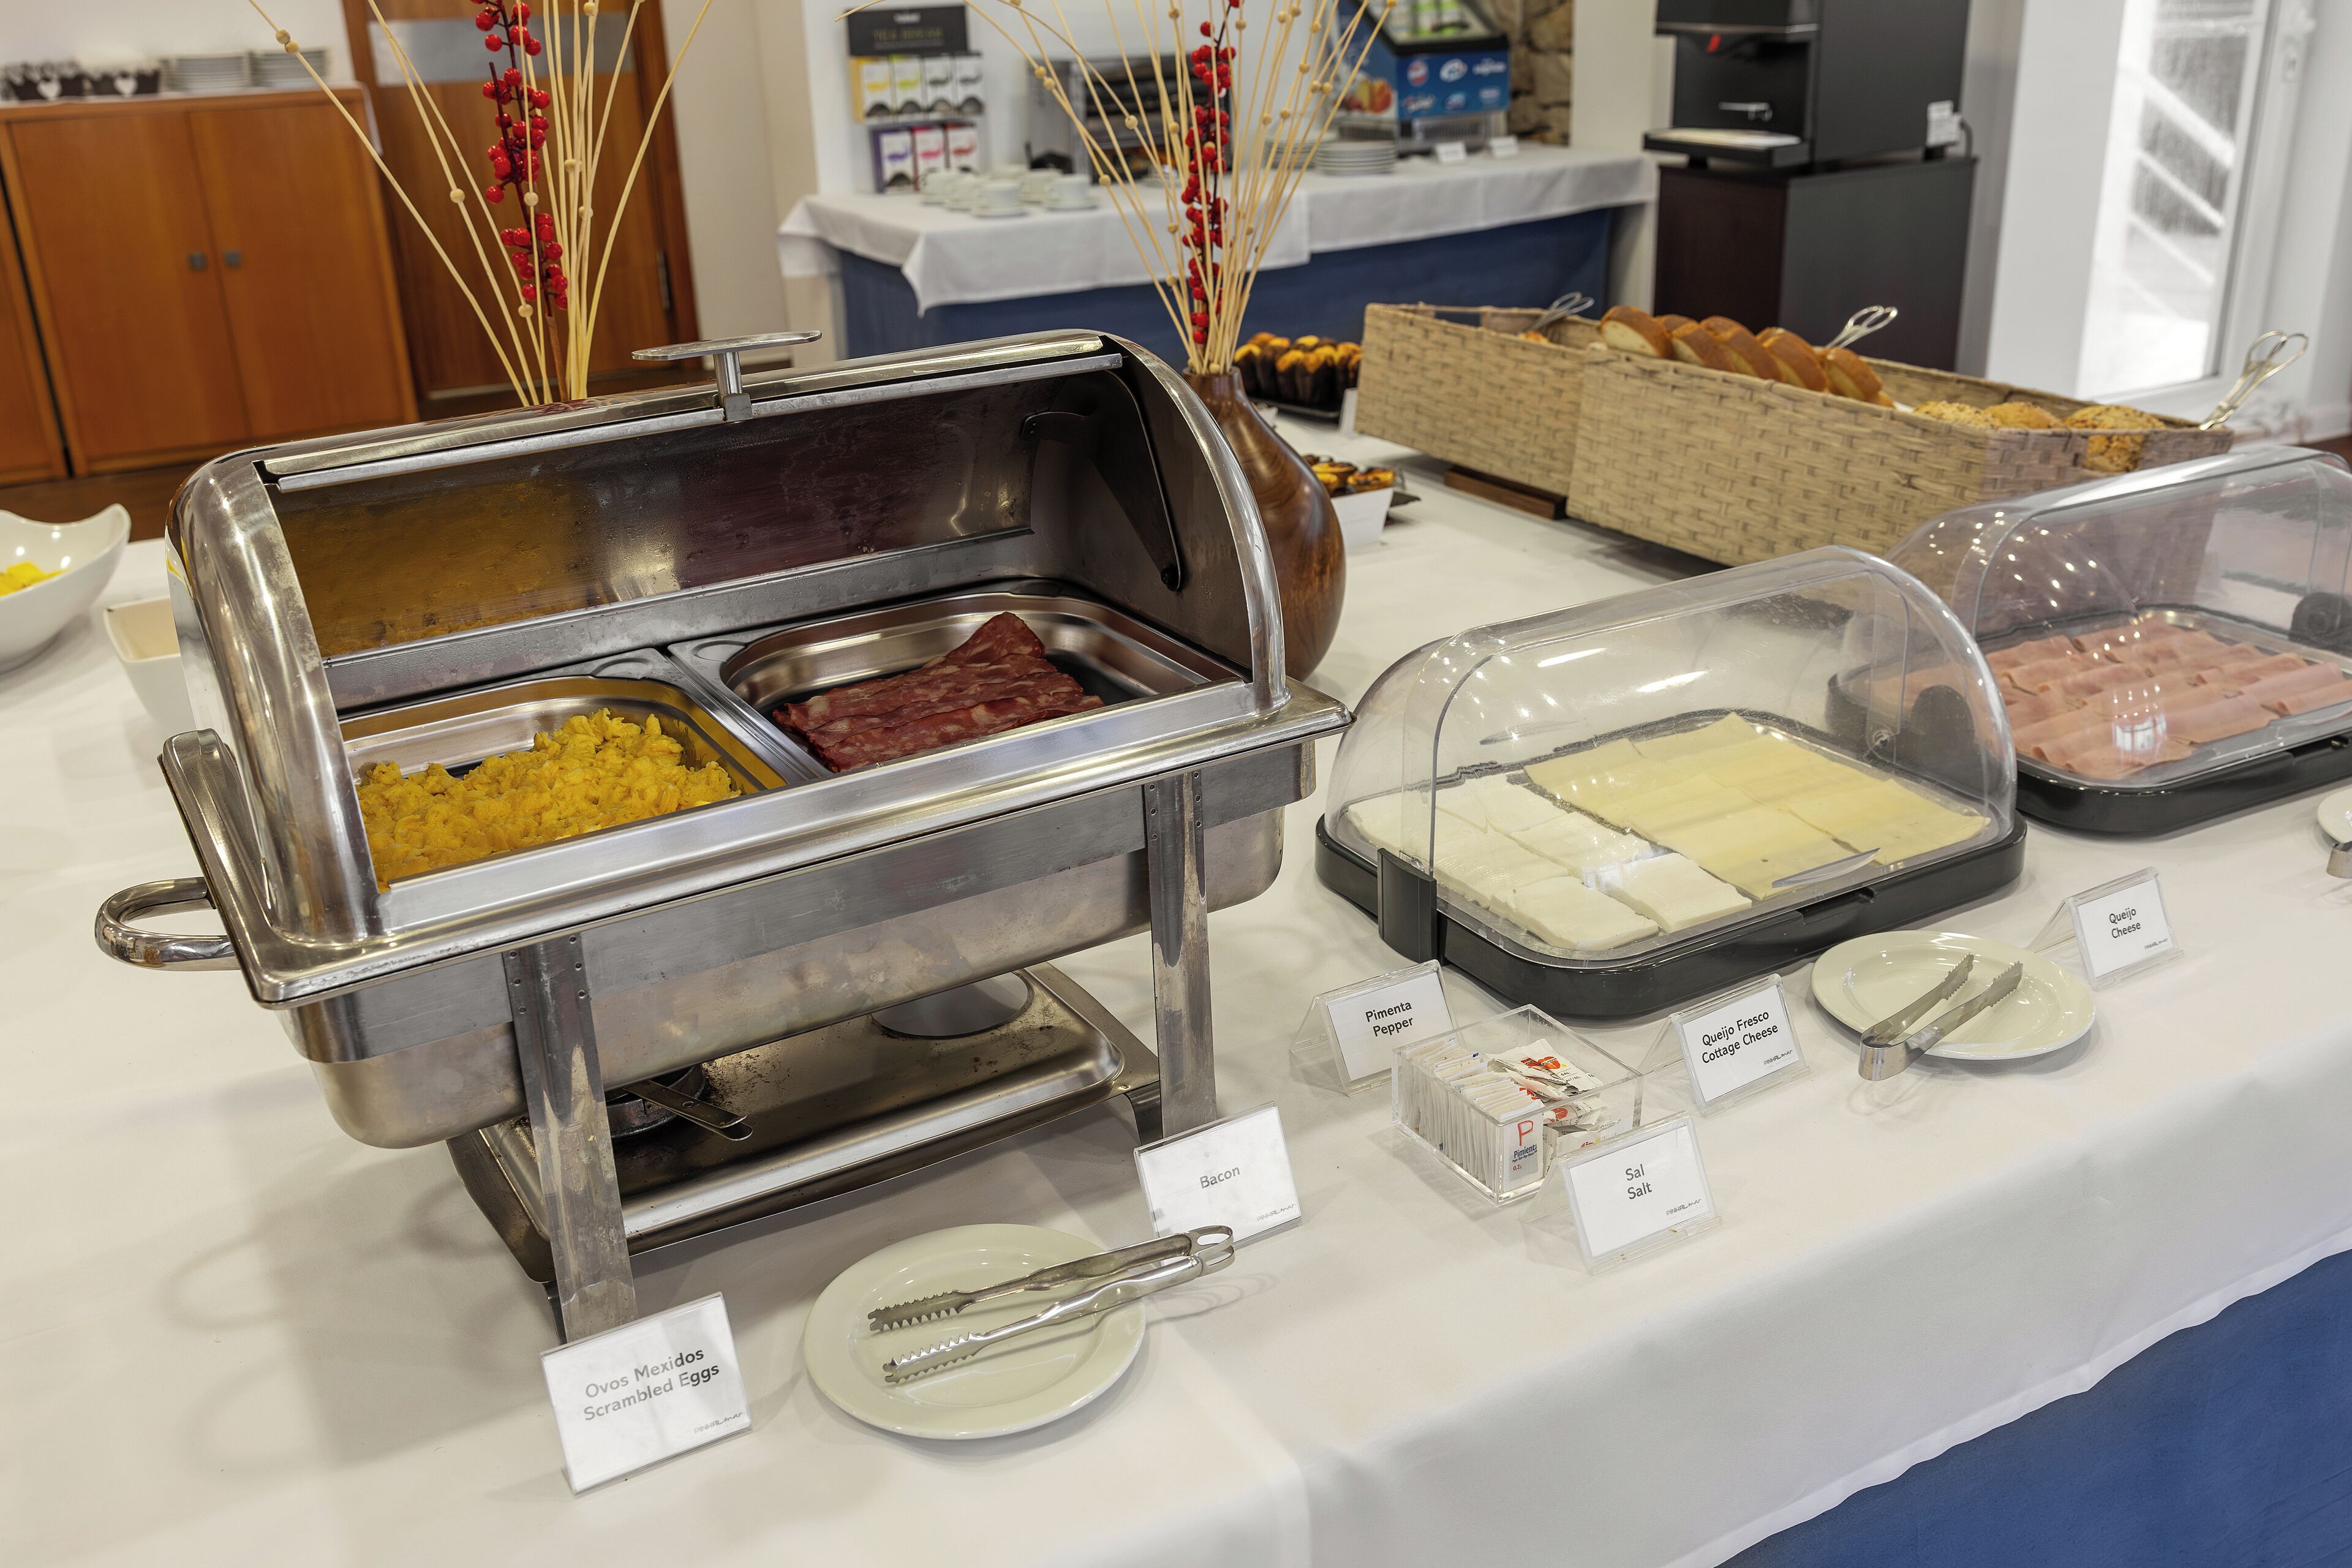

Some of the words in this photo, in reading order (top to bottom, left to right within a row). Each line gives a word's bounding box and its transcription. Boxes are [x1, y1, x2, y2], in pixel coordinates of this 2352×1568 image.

[2109, 907, 2136, 924] Queijo
[2111, 922, 2141, 938] Cheese
[1365, 1001, 1412, 1022] Pimenta
[1373, 1017, 1413, 1037] Pepper
[1702, 1026, 1735, 1046] Queijo
[1736, 1011, 1769, 1031] Fresco
[1702, 1041, 1741, 1063] Cottage
[1743, 1025, 1778, 1046] Cheese
[1517, 1120, 1534, 1147] P
[1199, 1166, 1240, 1189] Bacon
[1625, 1164, 1645, 1181] Sal
[1627, 1182, 1653, 1200] Salt
[586, 1376, 629, 1398] Ovos
[634, 1349, 704, 1382] Mexidos
[584, 1378, 673, 1421] Scrambled
[679, 1365, 720, 1387] Eggs
